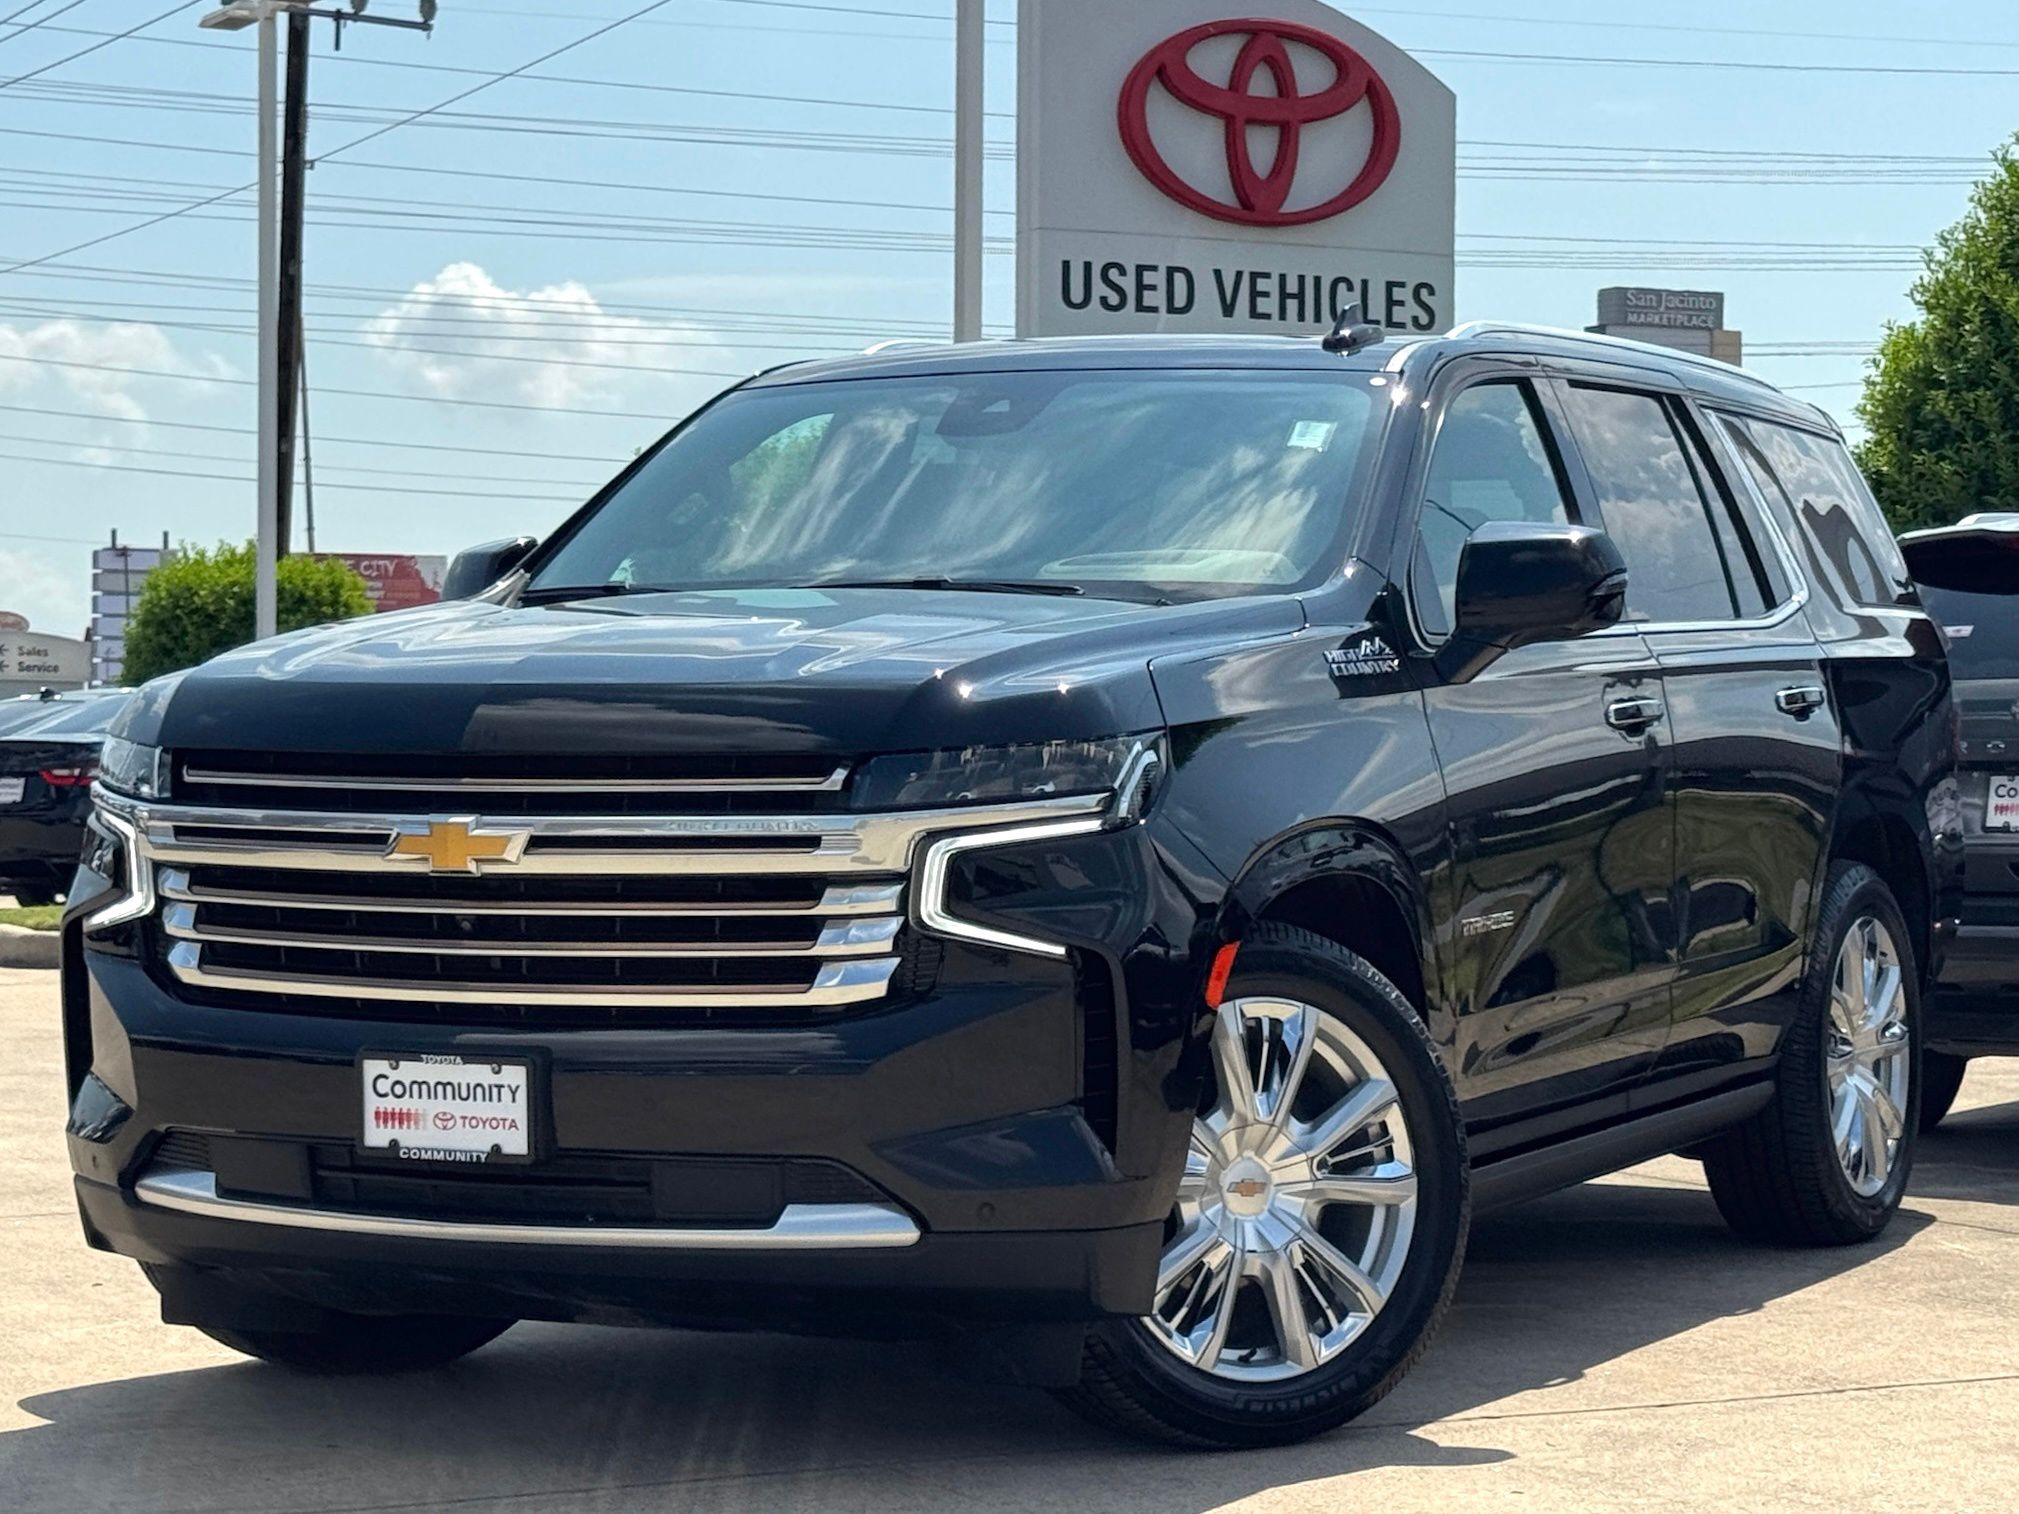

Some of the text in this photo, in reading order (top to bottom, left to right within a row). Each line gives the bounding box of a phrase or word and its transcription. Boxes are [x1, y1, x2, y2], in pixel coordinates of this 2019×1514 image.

[1060, 259, 1437, 332] USED VEHICLES
[1626, 289, 1717, 311] San Jacinto
[1626, 312, 1715, 328] MARKETPLACE
[359, 559, 397, 577] CITY
[17, 645, 49, 657] Sales
[17, 661, 60, 673] Service
[421, 1054, 464, 1065] TOYOTA
[460, 1115, 520, 1131] TOYOTA
[399, 1147, 489, 1163] COMMUNITY
